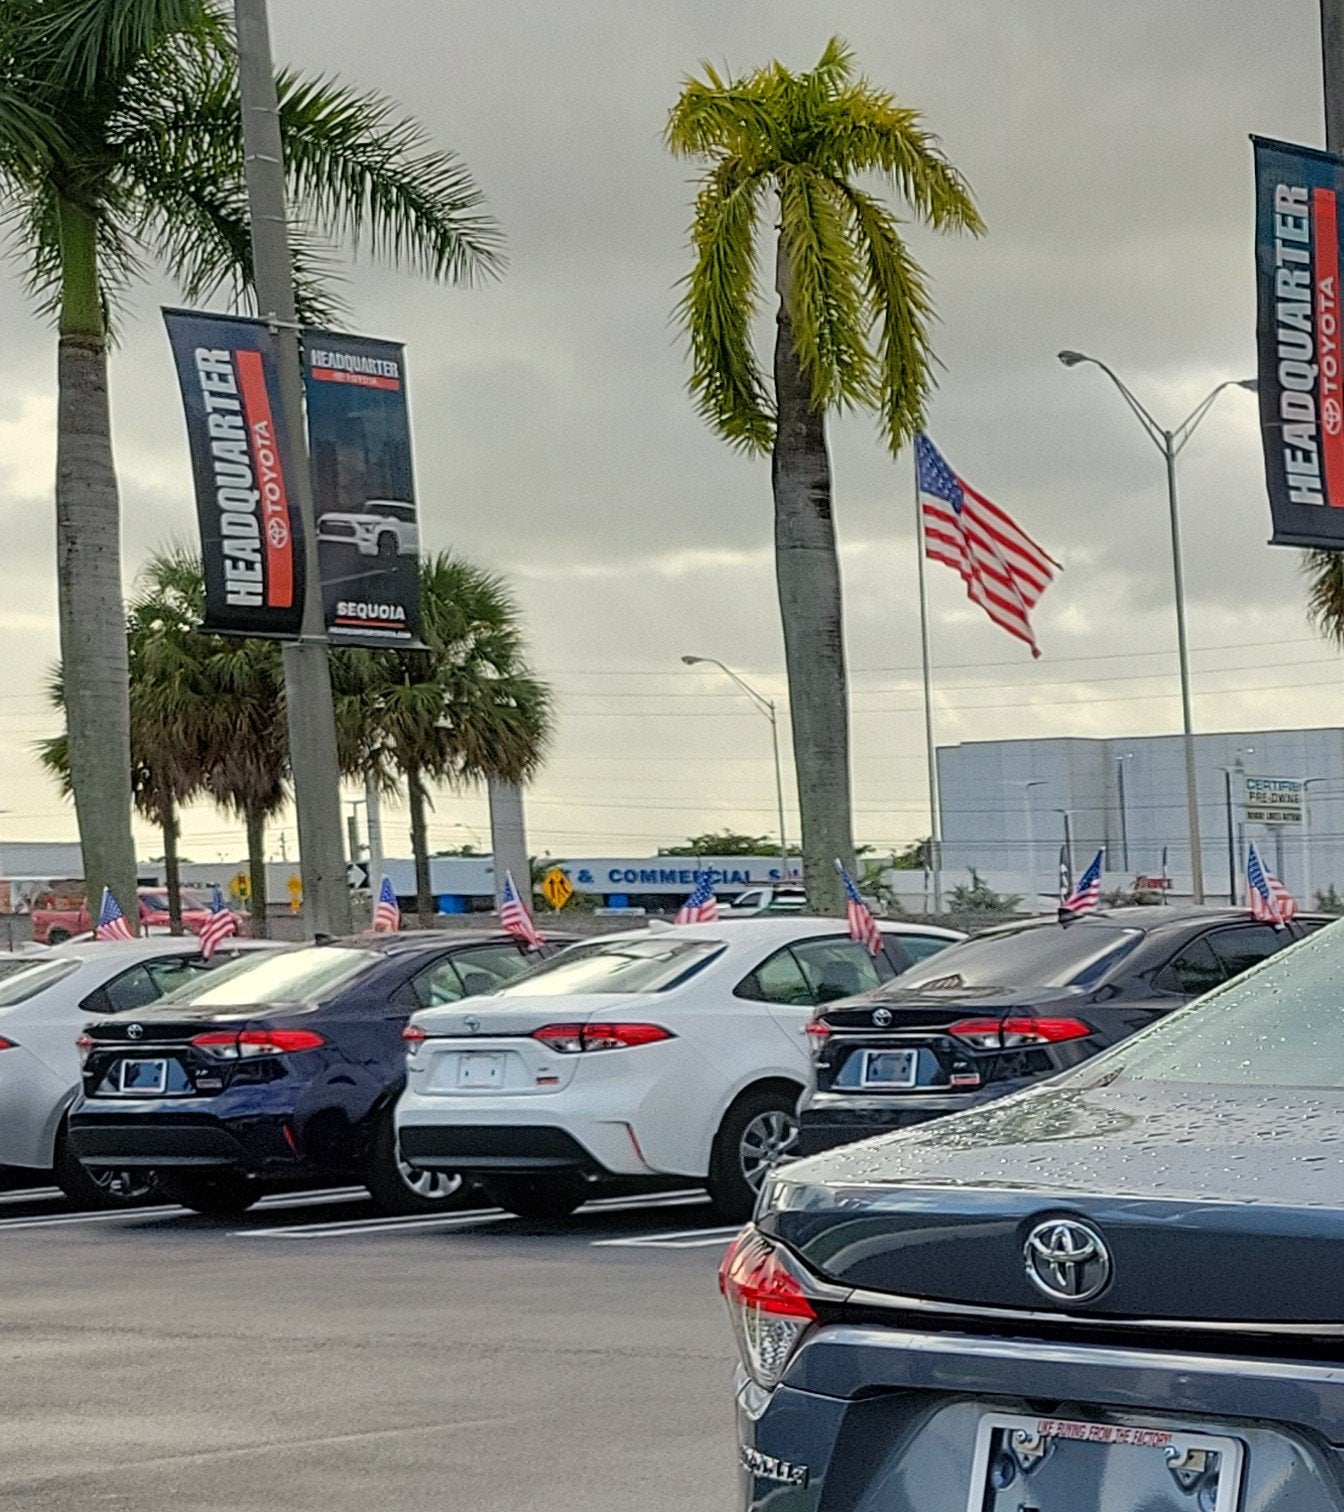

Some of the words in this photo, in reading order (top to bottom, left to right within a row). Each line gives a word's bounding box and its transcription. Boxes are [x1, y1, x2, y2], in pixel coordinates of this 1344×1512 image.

[311, 349, 399, 378] HEADQUARTER
[1275, 183, 1325, 506] HEADQUARTER
[1316, 276, 1339, 394] TOYOTA
[195, 347, 263, 606] HEADQUARTER
[254, 420, 282, 514] TOYOTA
[337, 601, 406, 620] SEQUOIA
